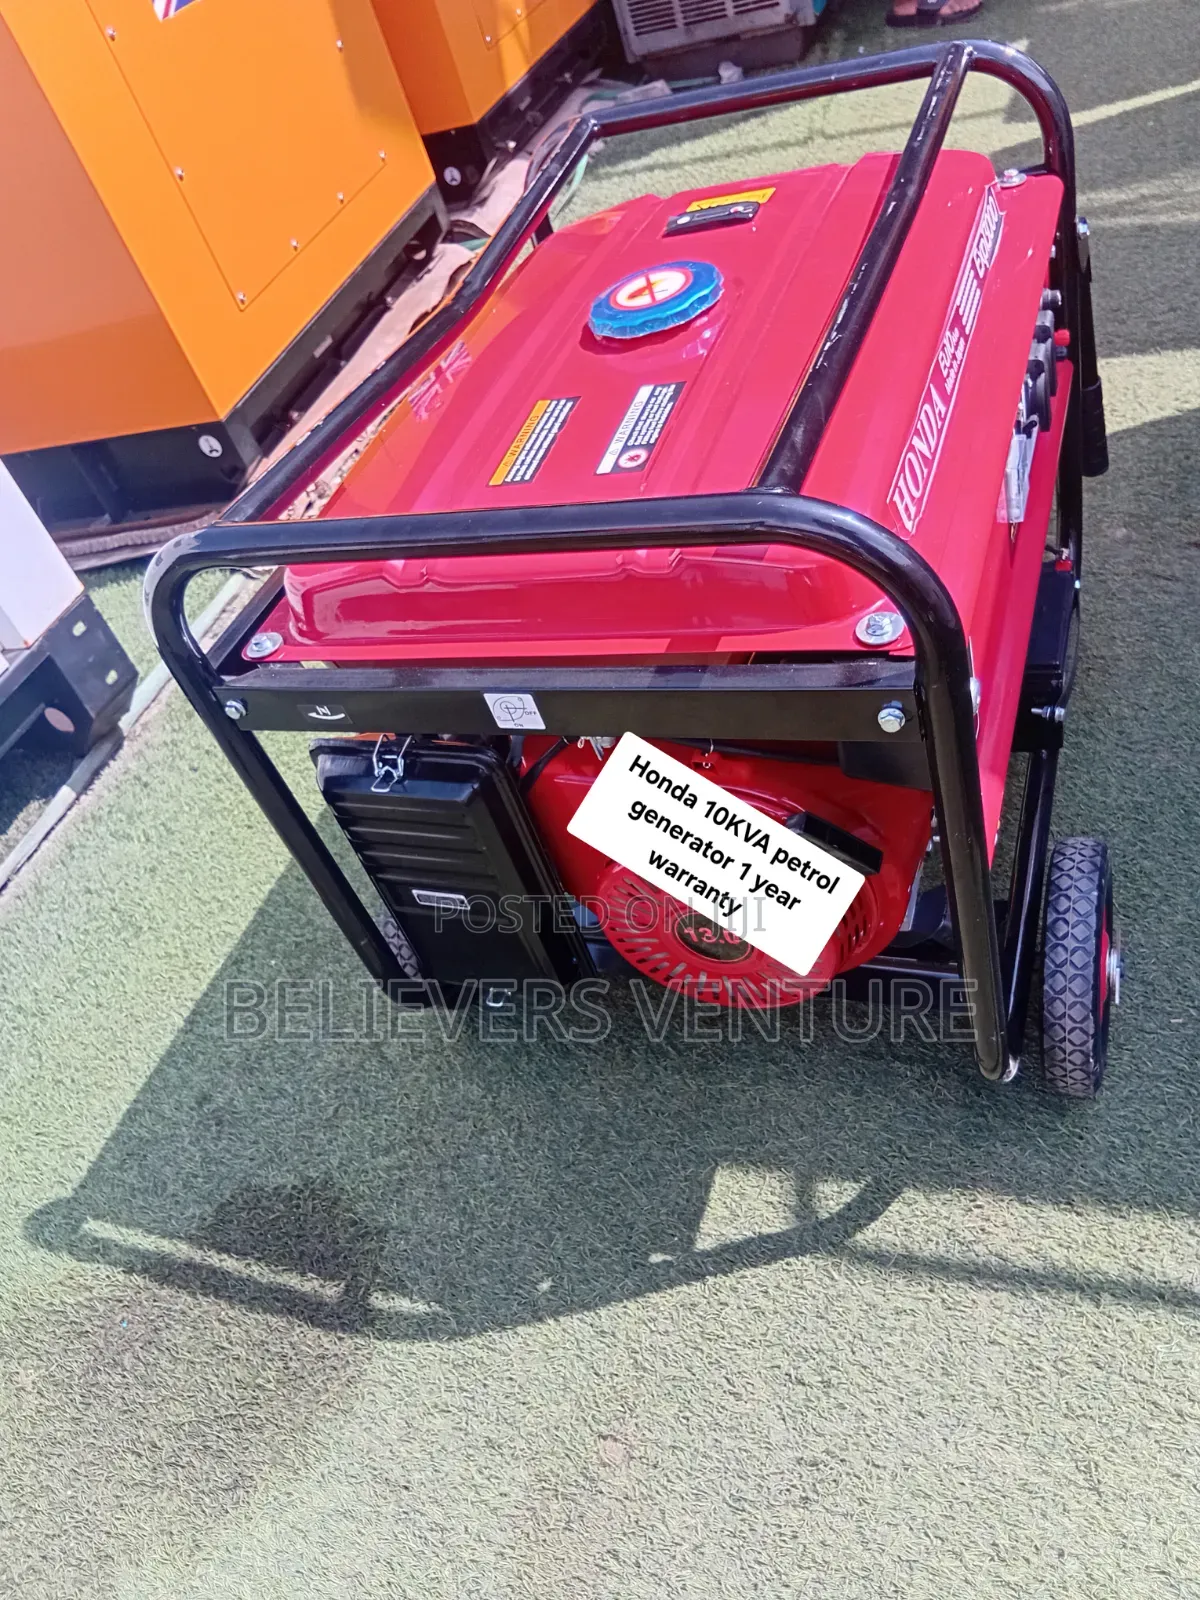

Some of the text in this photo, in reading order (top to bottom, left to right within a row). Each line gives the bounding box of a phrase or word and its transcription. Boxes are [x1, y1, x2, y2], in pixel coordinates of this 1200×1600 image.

[509, 415, 540, 458] WARNING
[614, 400, 645, 444] WARNING
[892, 383, 947, 533] HONDA
